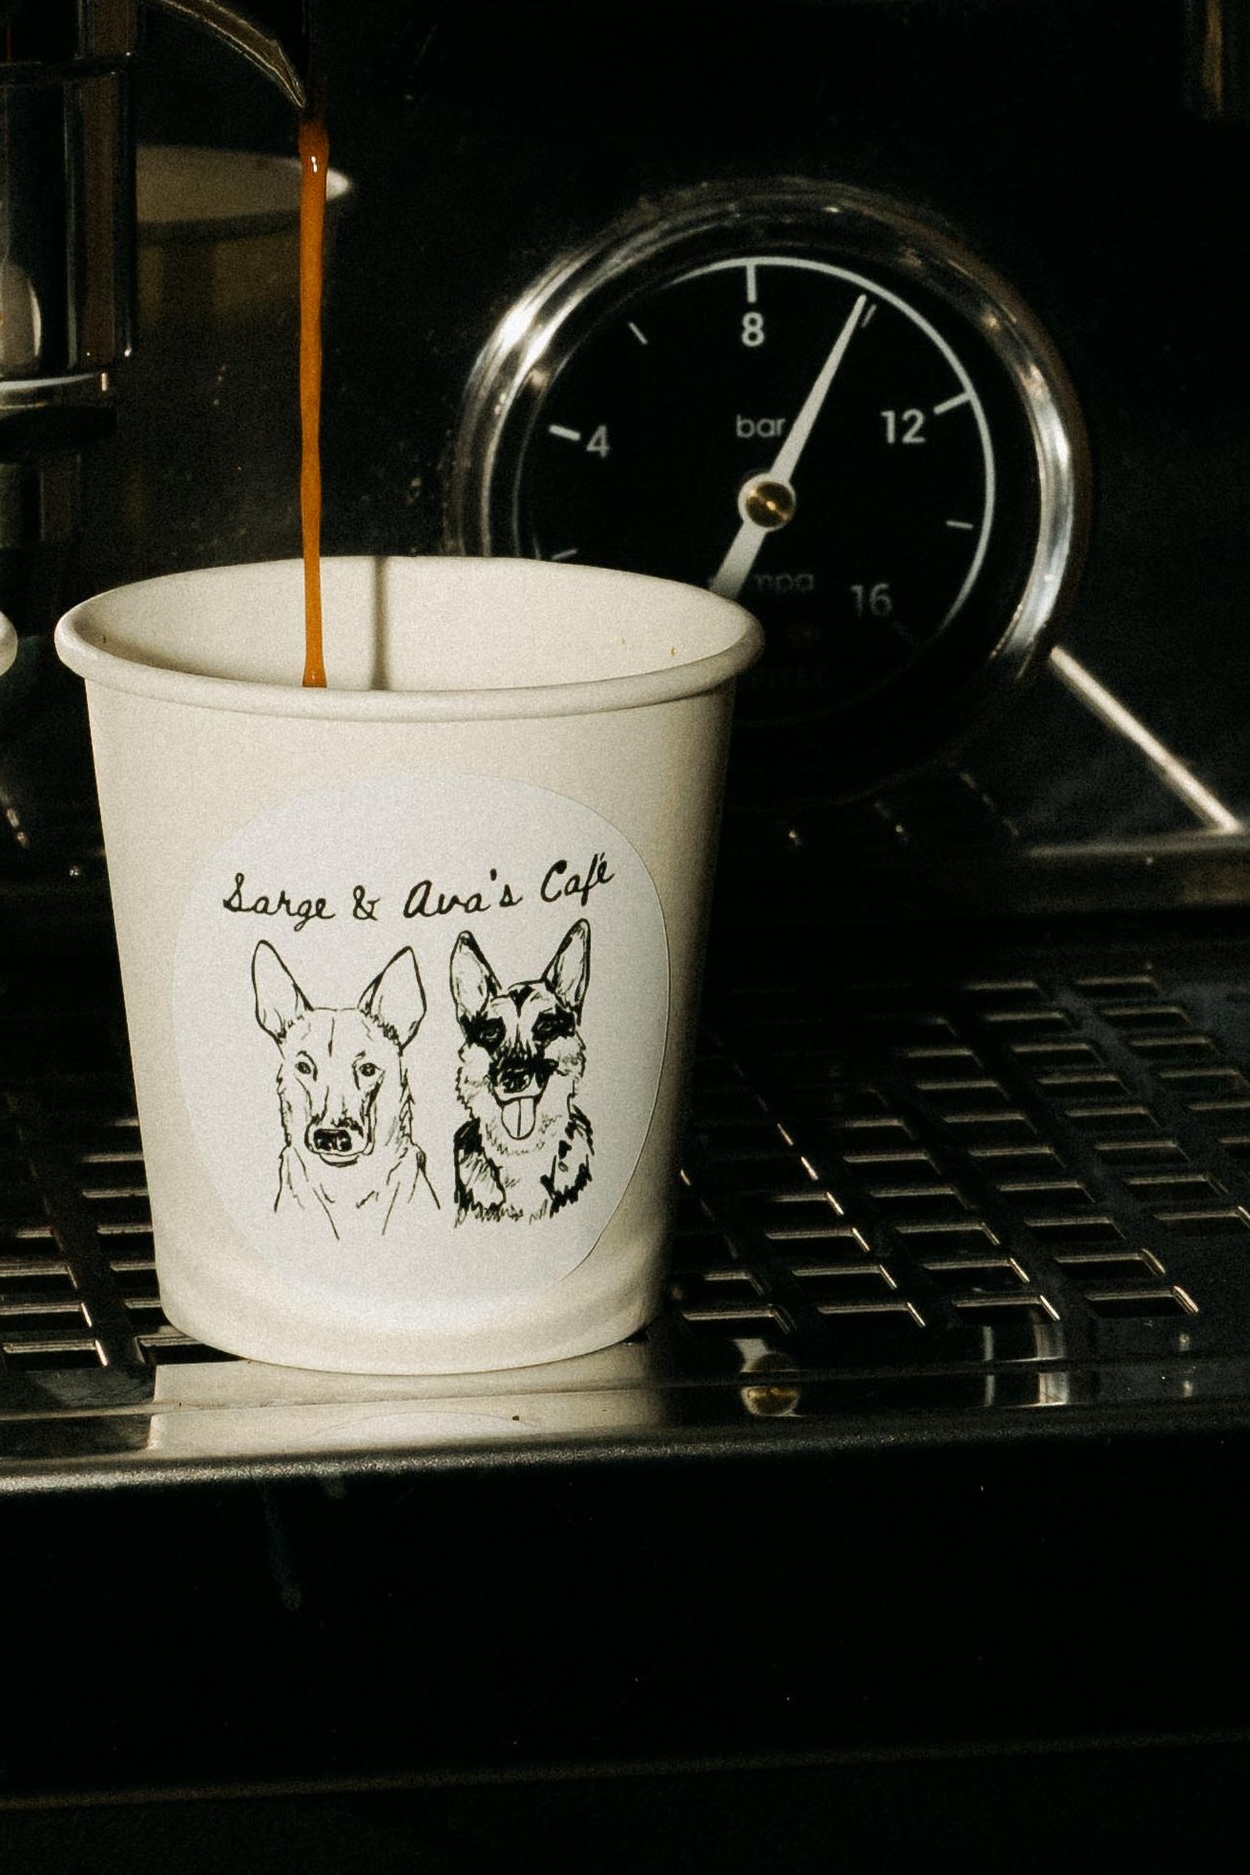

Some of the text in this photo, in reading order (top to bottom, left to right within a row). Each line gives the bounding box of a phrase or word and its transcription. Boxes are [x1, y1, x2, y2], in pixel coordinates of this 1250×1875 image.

[741, 312, 765, 347] 8
[586, 425, 611, 459] 4
[736, 414, 786, 440] bar
[880, 409, 926, 444] 12
[851, 581, 893, 618] 16
[222, 872, 337, 932] Sarge
[352, 885, 380, 921] &
[402, 868, 524, 920] Ava's
